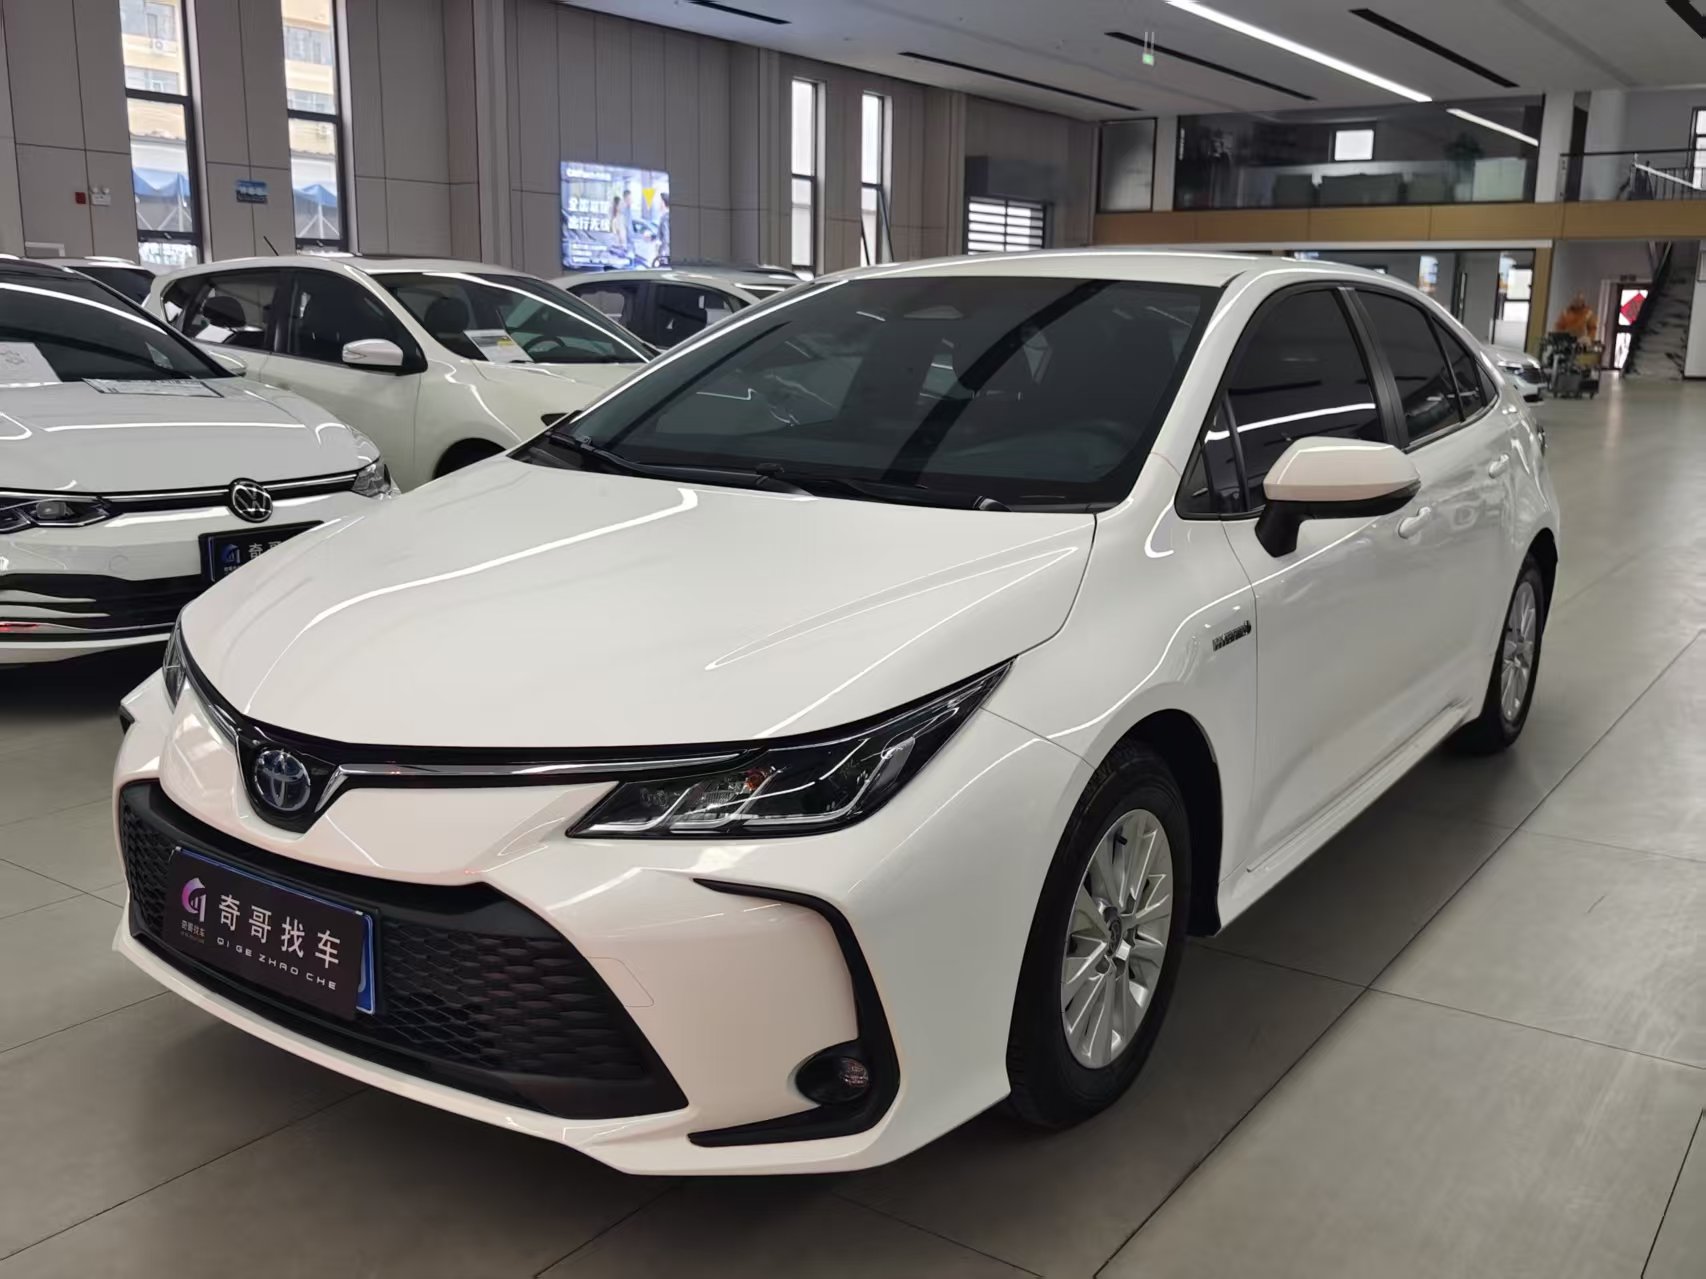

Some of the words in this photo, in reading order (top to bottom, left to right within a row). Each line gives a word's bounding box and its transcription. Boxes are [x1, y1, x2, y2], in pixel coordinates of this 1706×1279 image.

[218, 894, 341, 969] 奇哥找车
[235, 945, 253, 957] GE
[258, 954, 299, 975] ZHAO
[306, 972, 337, 990] CHE
